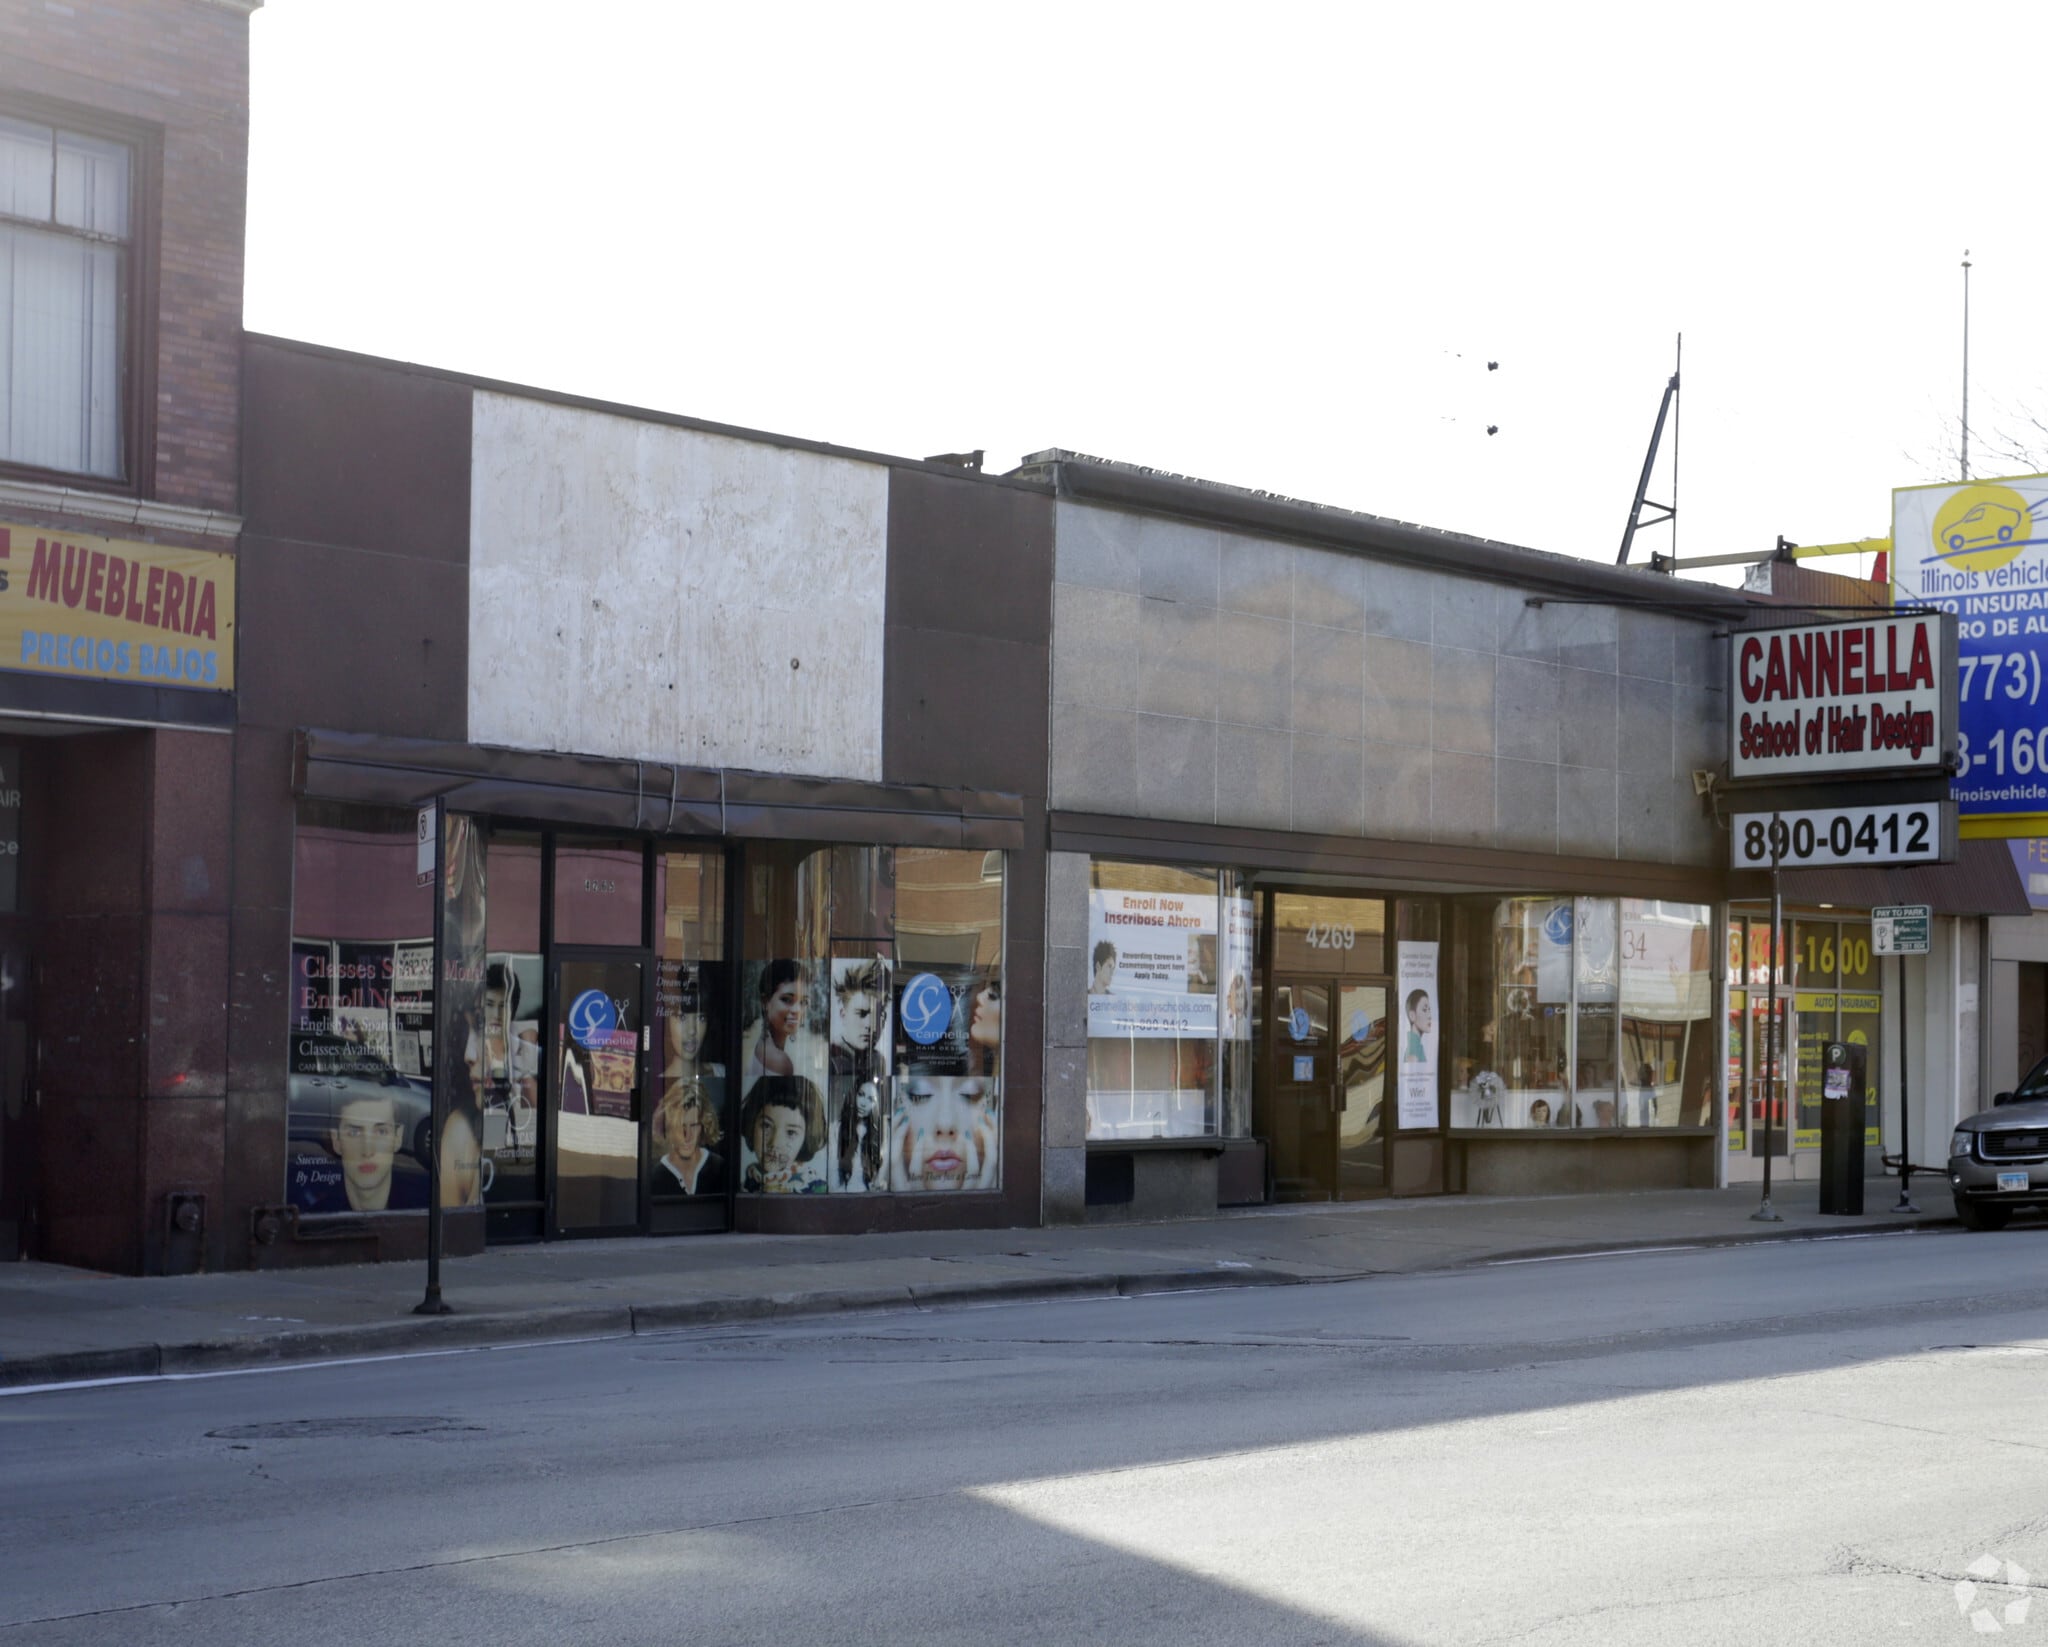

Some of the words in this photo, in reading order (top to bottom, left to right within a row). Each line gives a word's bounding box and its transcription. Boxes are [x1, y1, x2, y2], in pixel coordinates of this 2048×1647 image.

[1921, 565, 1979, 593] illinois
[1985, 559, 2048, 588] vehicl
[26, 537, 216, 641] MUEBLERIA
[1905, 598, 1959, 615] ATO
[1958, 621, 1986, 640] RO
[1992, 617, 2019, 638] DE
[20, 629, 131, 674] PRECIOS
[139, 643, 218, 684] BAJOS
[1740, 622, 1935, 704] CANNELLA
[1958, 650, 2041, 705] 773)
[1740, 709, 1800, 760] School
[1804, 706, 1824, 756] of
[1828, 704, 1867, 754] Hair
[1871, 700, 1935, 761] Design
[1956, 726, 2048, 778] 3-160
[1950, 783, 2048, 803] linoisvehicle.
[1744, 811, 1930, 861] 890-0412
[1123, 897, 1156, 910] Enroll
[1160, 898, 1184, 912] Now
[1876, 910, 1890, 918] PAY
[1892, 909, 1903, 917] TO
[1903, 908, 1925, 917] PARK
[1105, 912, 1164, 927] Inscribase
[1168, 914, 1201, 928] Ahora
[1306, 923, 1355, 950] 4269
[302, 955, 376, 980] Classes
[301, 986, 363, 1010] Enroll
[1815, 997, 1834, 1008] AUTO
[1841, 997, 1878, 1009] NSURANCE
[300, 1016, 340, 1036] English
[916, 1029, 970, 1039] cannella
[299, 1040, 341, 1056] Classes
[342, 1040, 393, 1056] Available
[296, 1170, 308, 1185] By
[310, 1170, 342, 1186] Design
